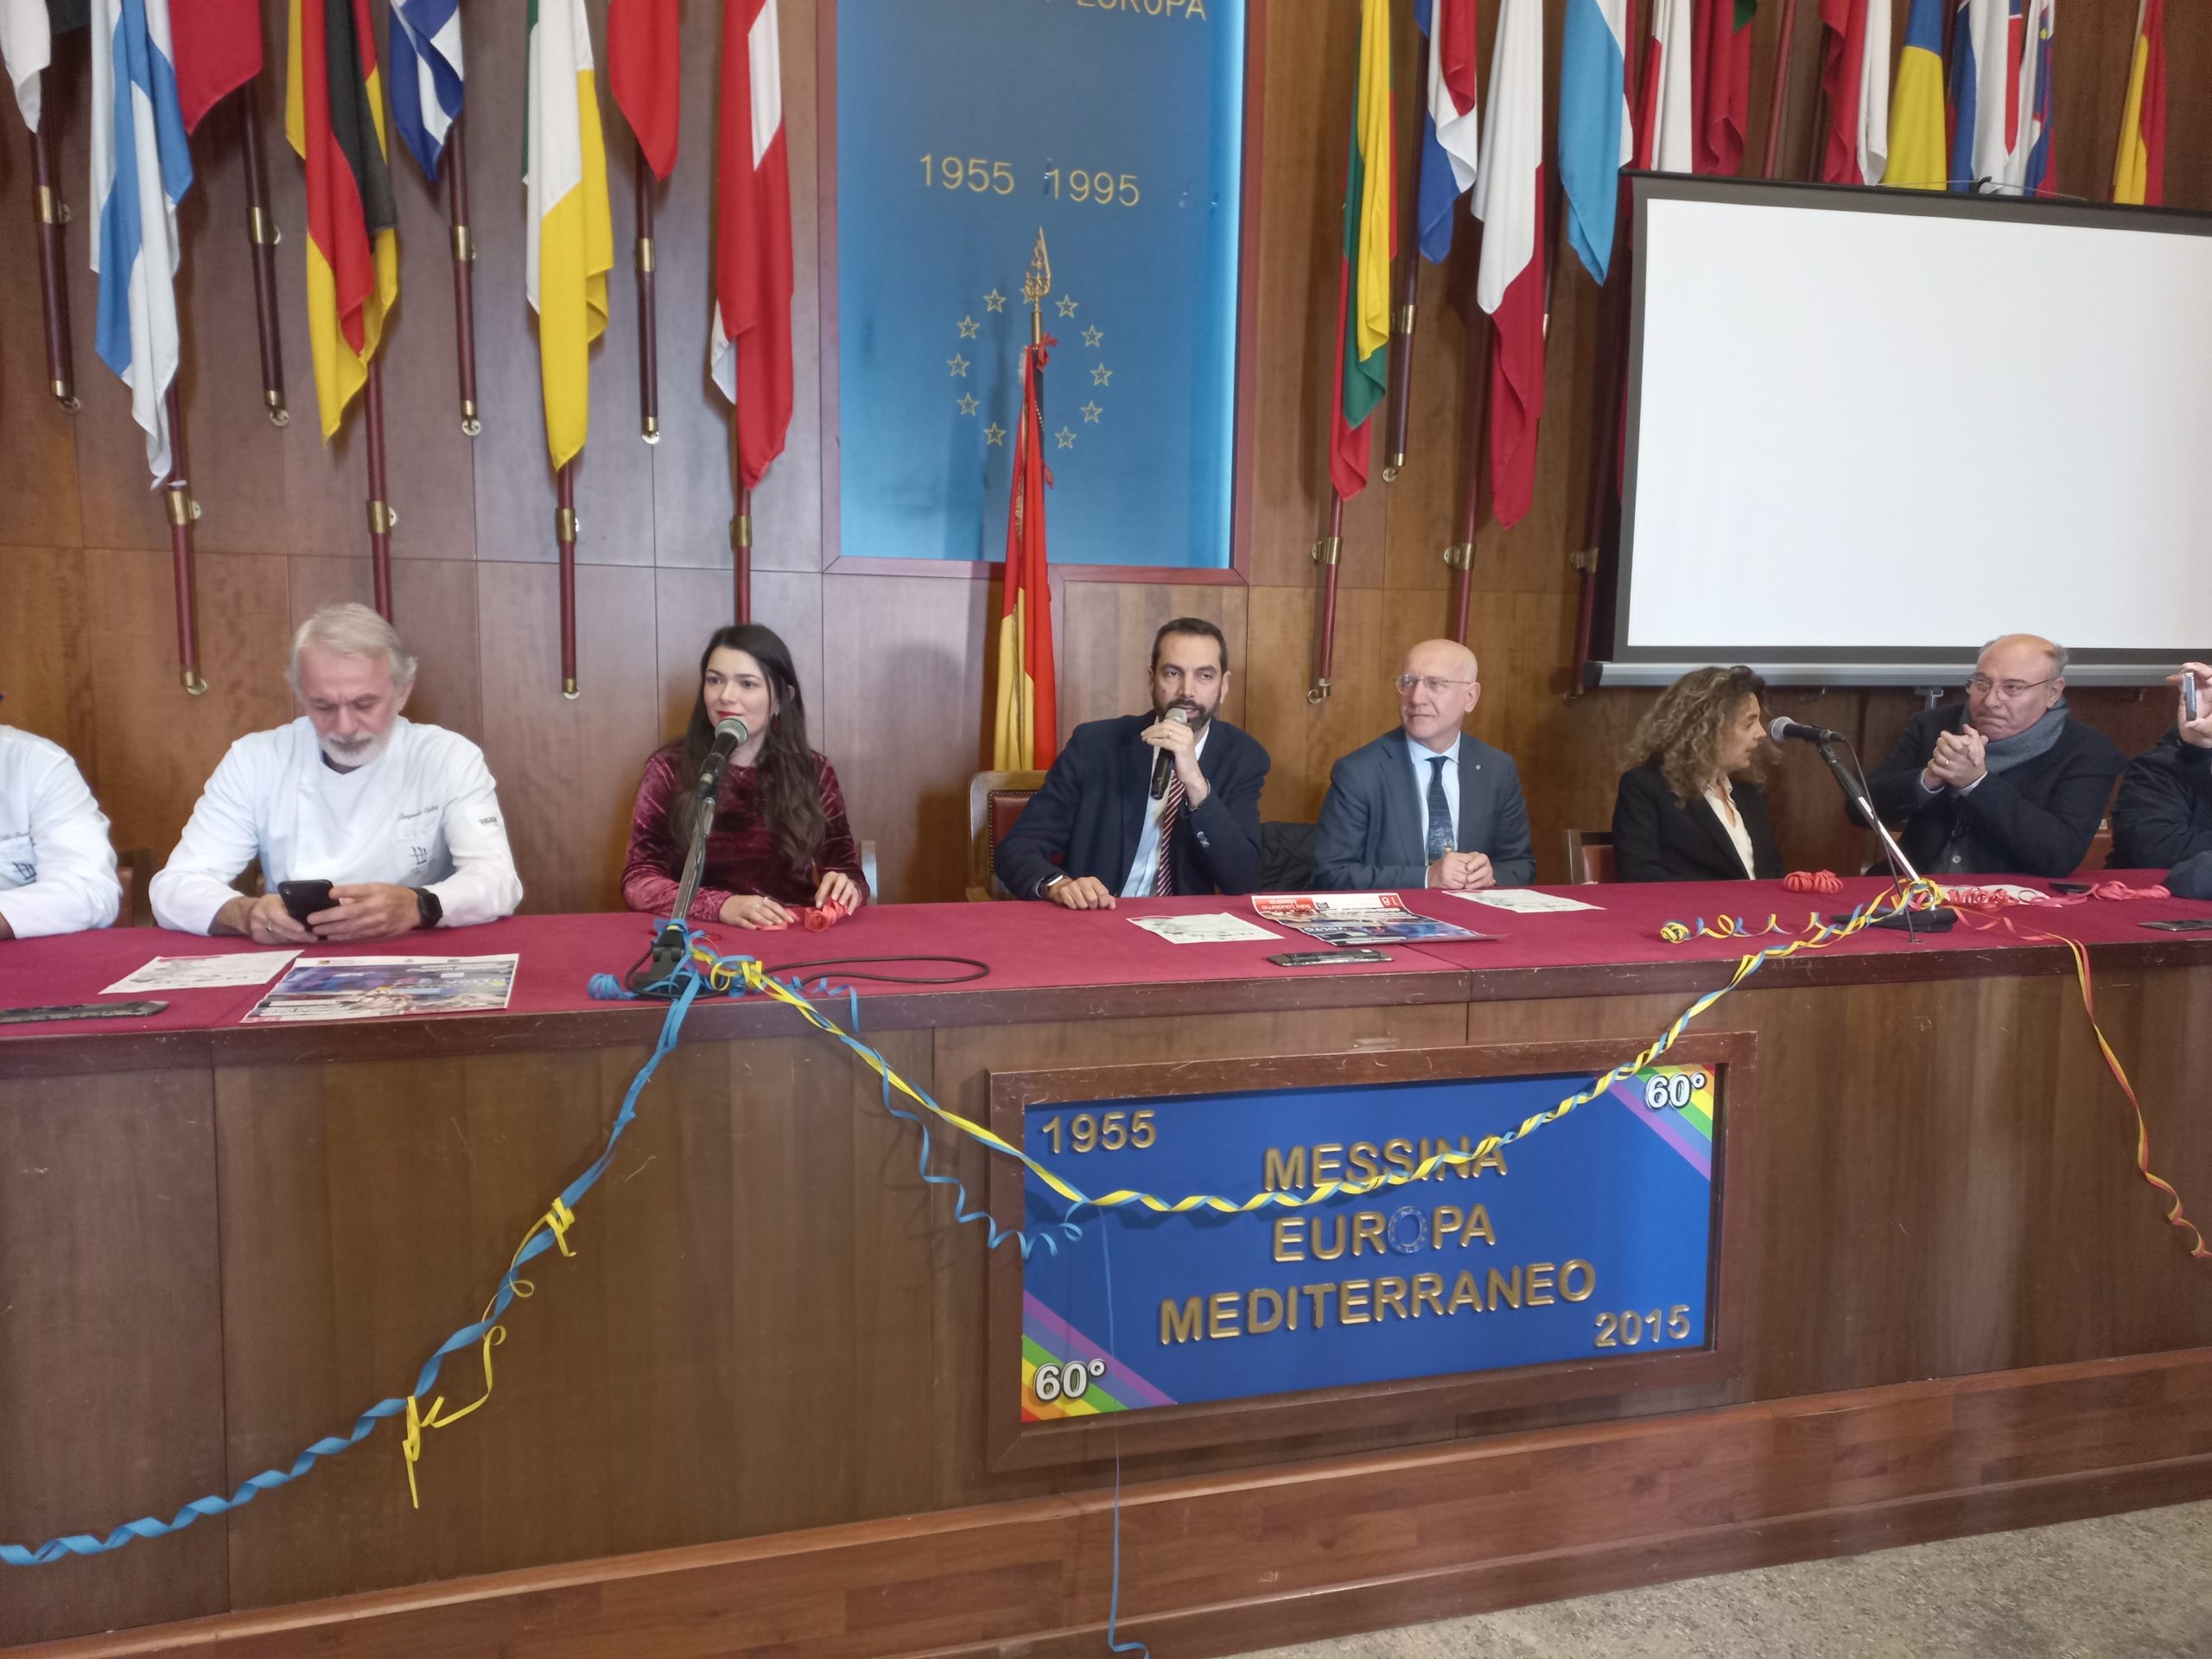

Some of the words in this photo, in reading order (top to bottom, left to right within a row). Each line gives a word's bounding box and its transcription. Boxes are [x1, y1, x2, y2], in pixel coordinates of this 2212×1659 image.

[1077, 0, 1206, 21] OPA
[919, 154, 1015, 194] 1955
[1049, 168, 1140, 207] 1995
[1382, 897, 1399, 906] 18
[1645, 1071, 1707, 1110] 60°
[1042, 1109, 1156, 1154] 1955
[1264, 1133, 1508, 1192] MESSINA
[1274, 1203, 1497, 1262] EUROPA
[1160, 1258, 1597, 1344] MEDITERRANEO
[1594, 1304, 1690, 1348] 2015
[1033, 1357, 1106, 1401] 60°
